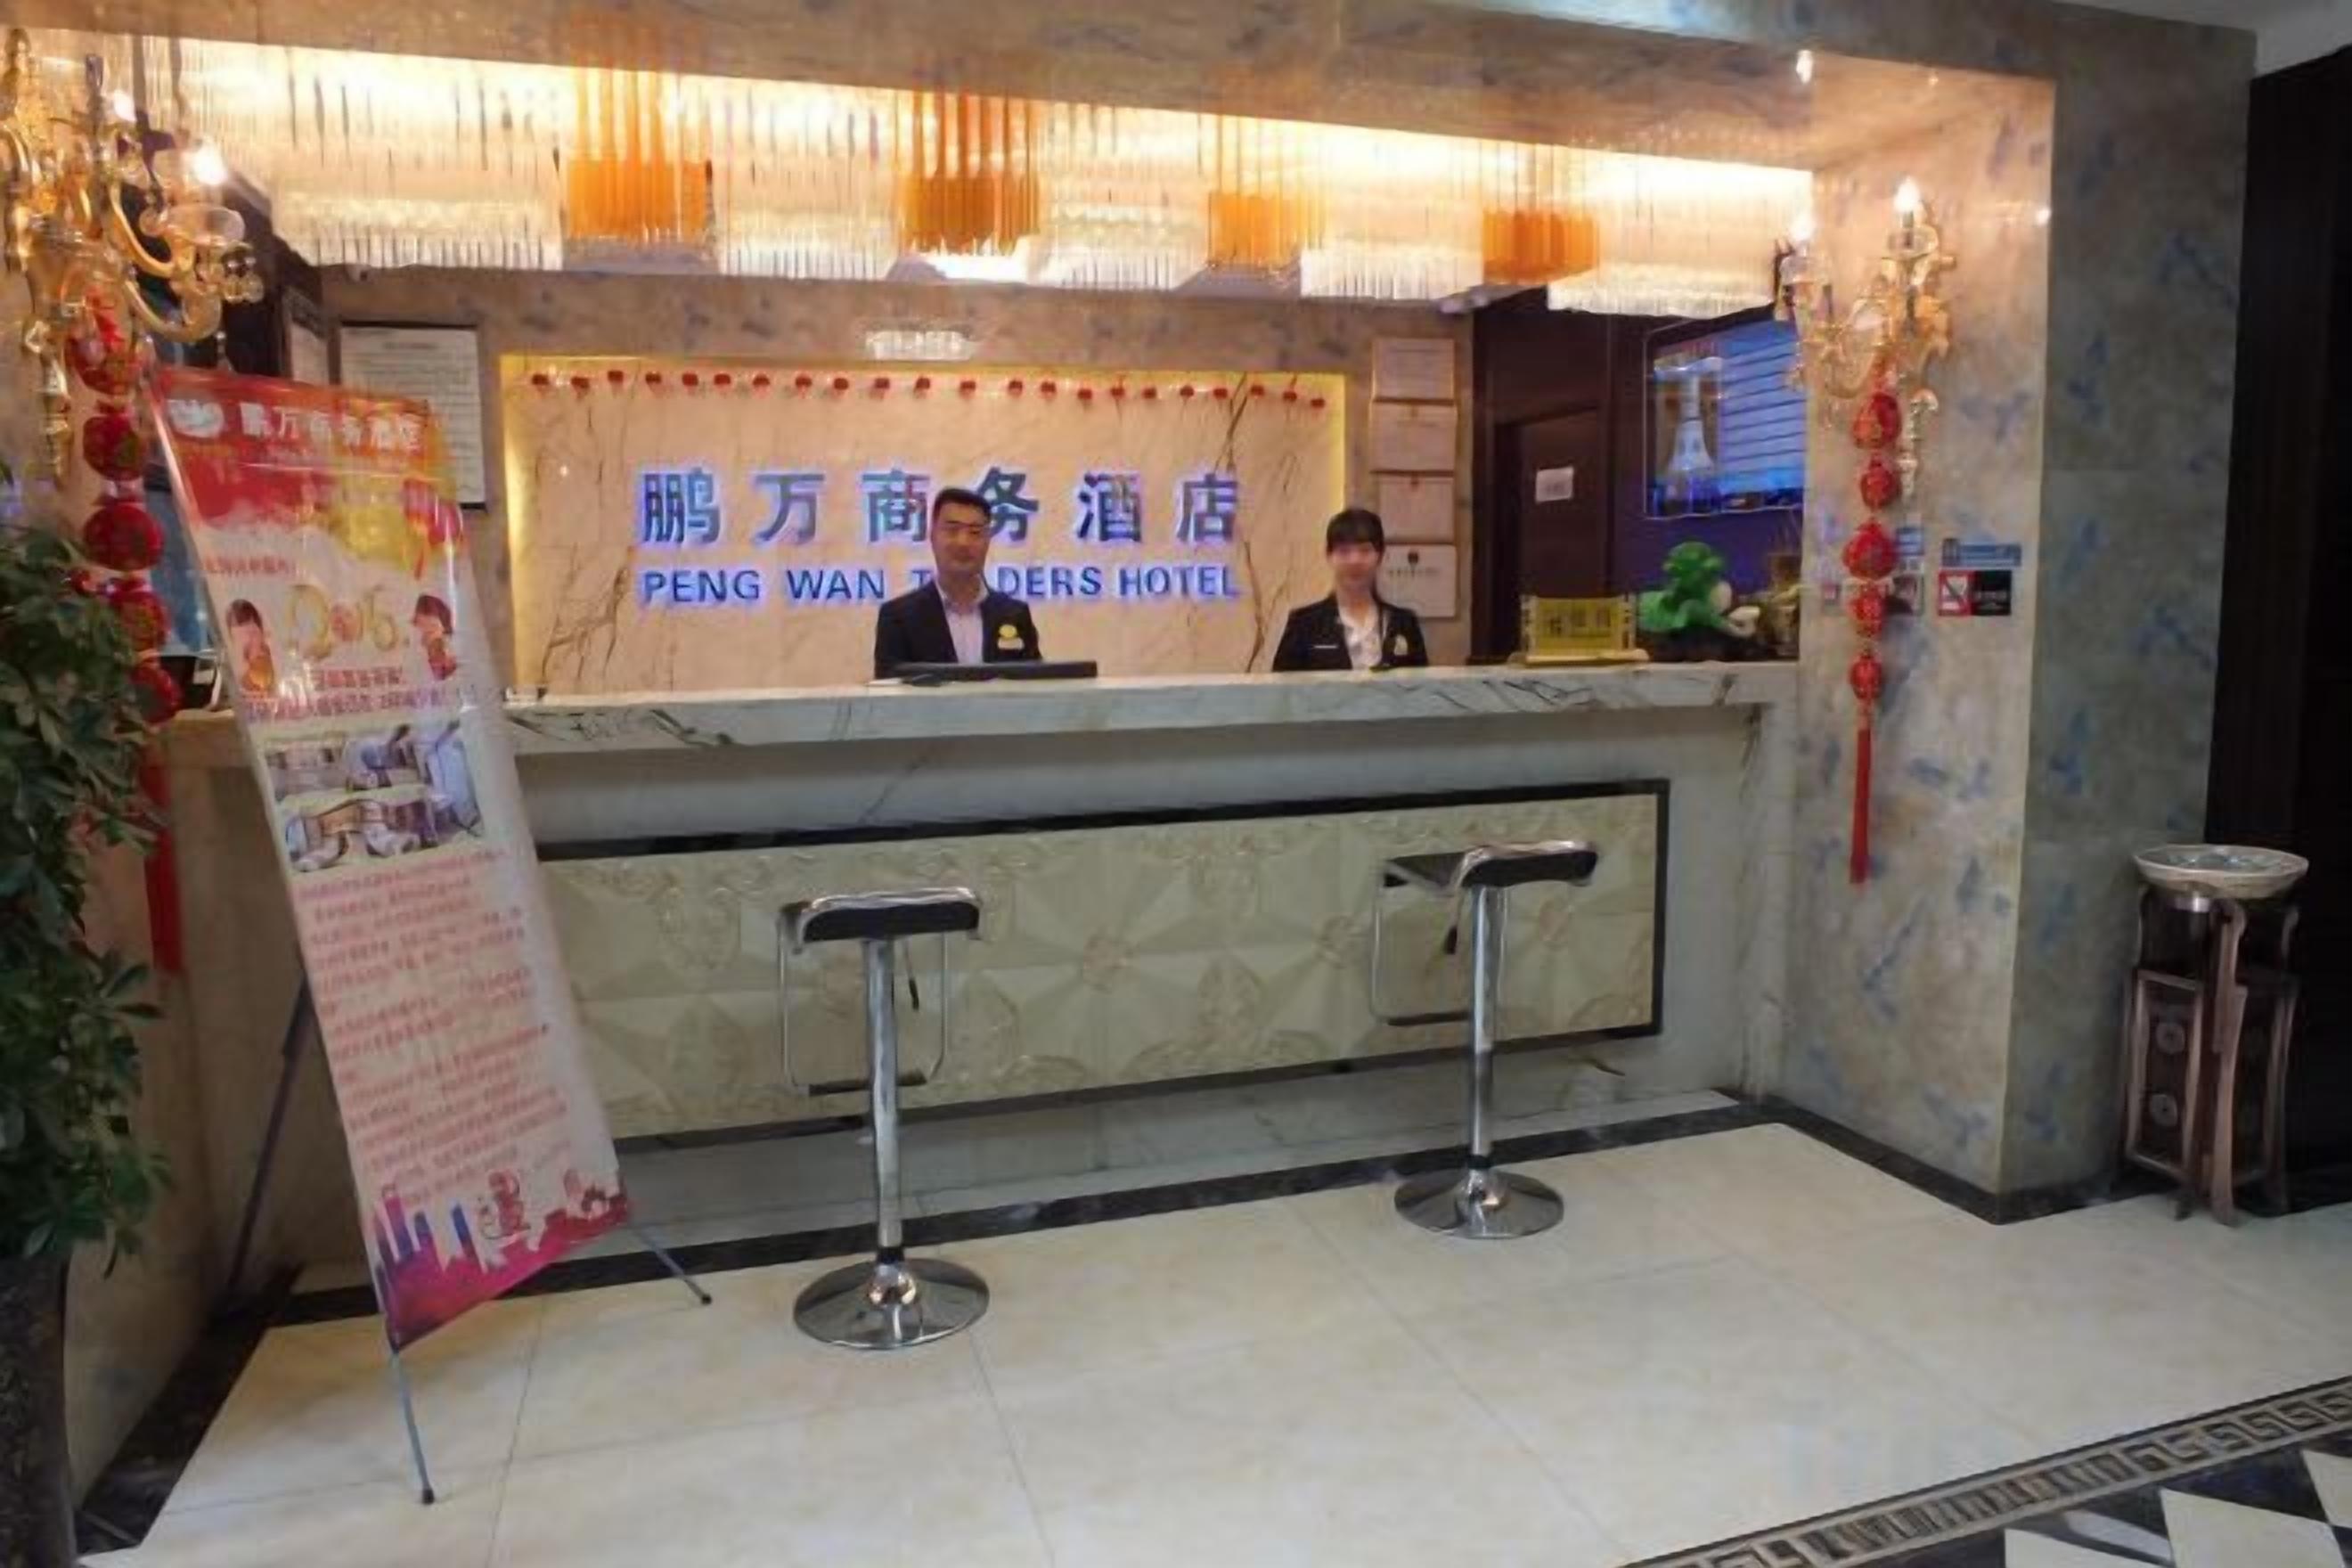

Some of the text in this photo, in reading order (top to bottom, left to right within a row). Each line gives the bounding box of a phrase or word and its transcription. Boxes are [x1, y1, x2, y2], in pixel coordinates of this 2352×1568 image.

[641, 467, 1238, 543] 鹏万商务酒店
[642, 565, 1239, 602] PENG WAN TDERS HOTEL
